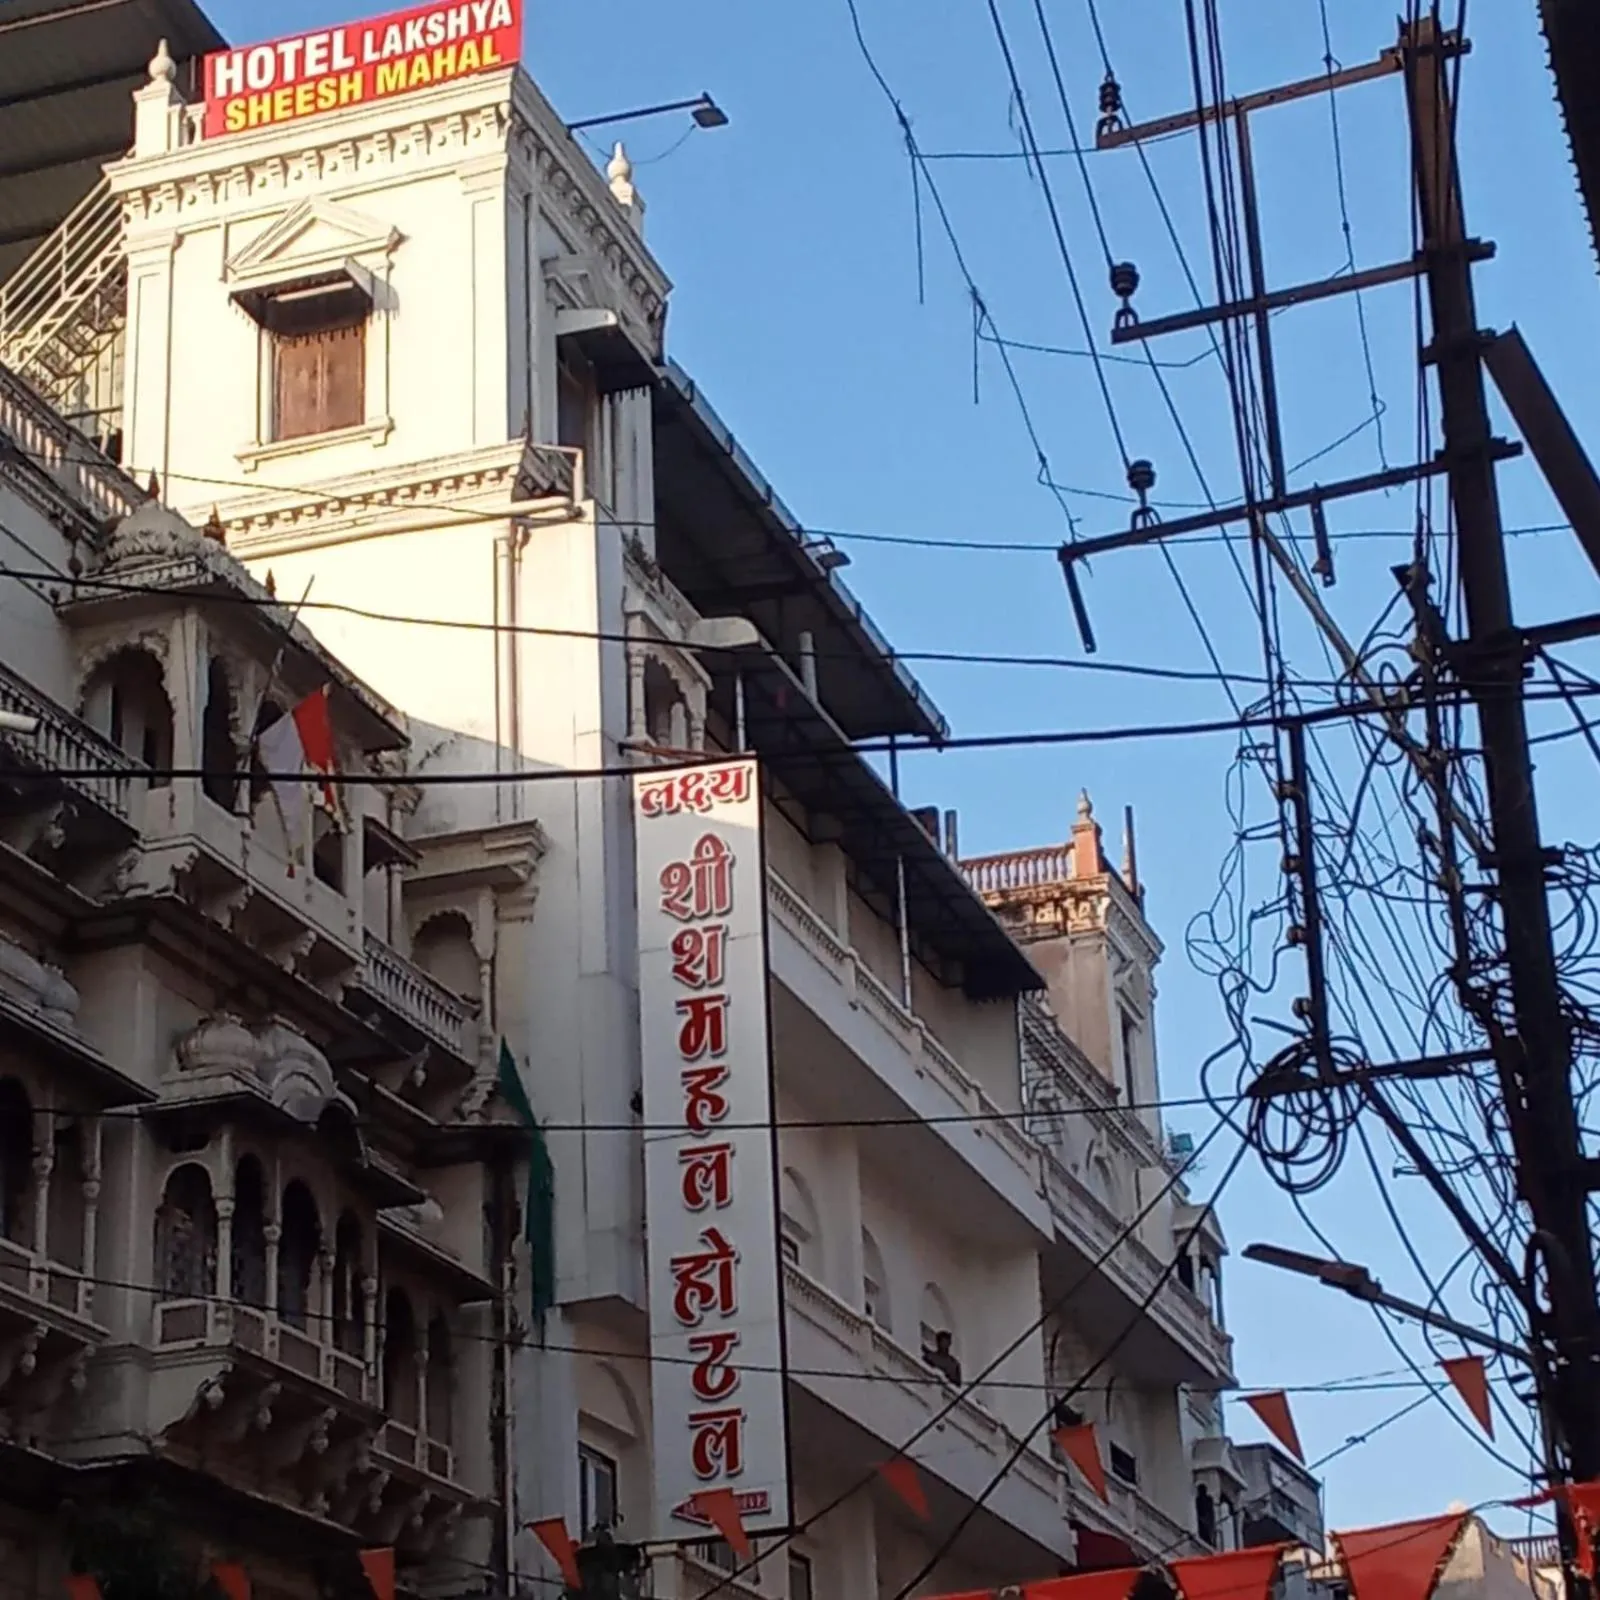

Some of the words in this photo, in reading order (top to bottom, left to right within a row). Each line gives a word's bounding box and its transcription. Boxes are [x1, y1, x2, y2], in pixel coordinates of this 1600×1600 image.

[214, 29, 354, 97] HOTEL
[363, 0, 512, 63] LAKSHYA
[224, 70, 363, 131] SHEESH
[376, 35, 501, 93] MAHAL
[638, 764, 752, 816] लक्ष्य
